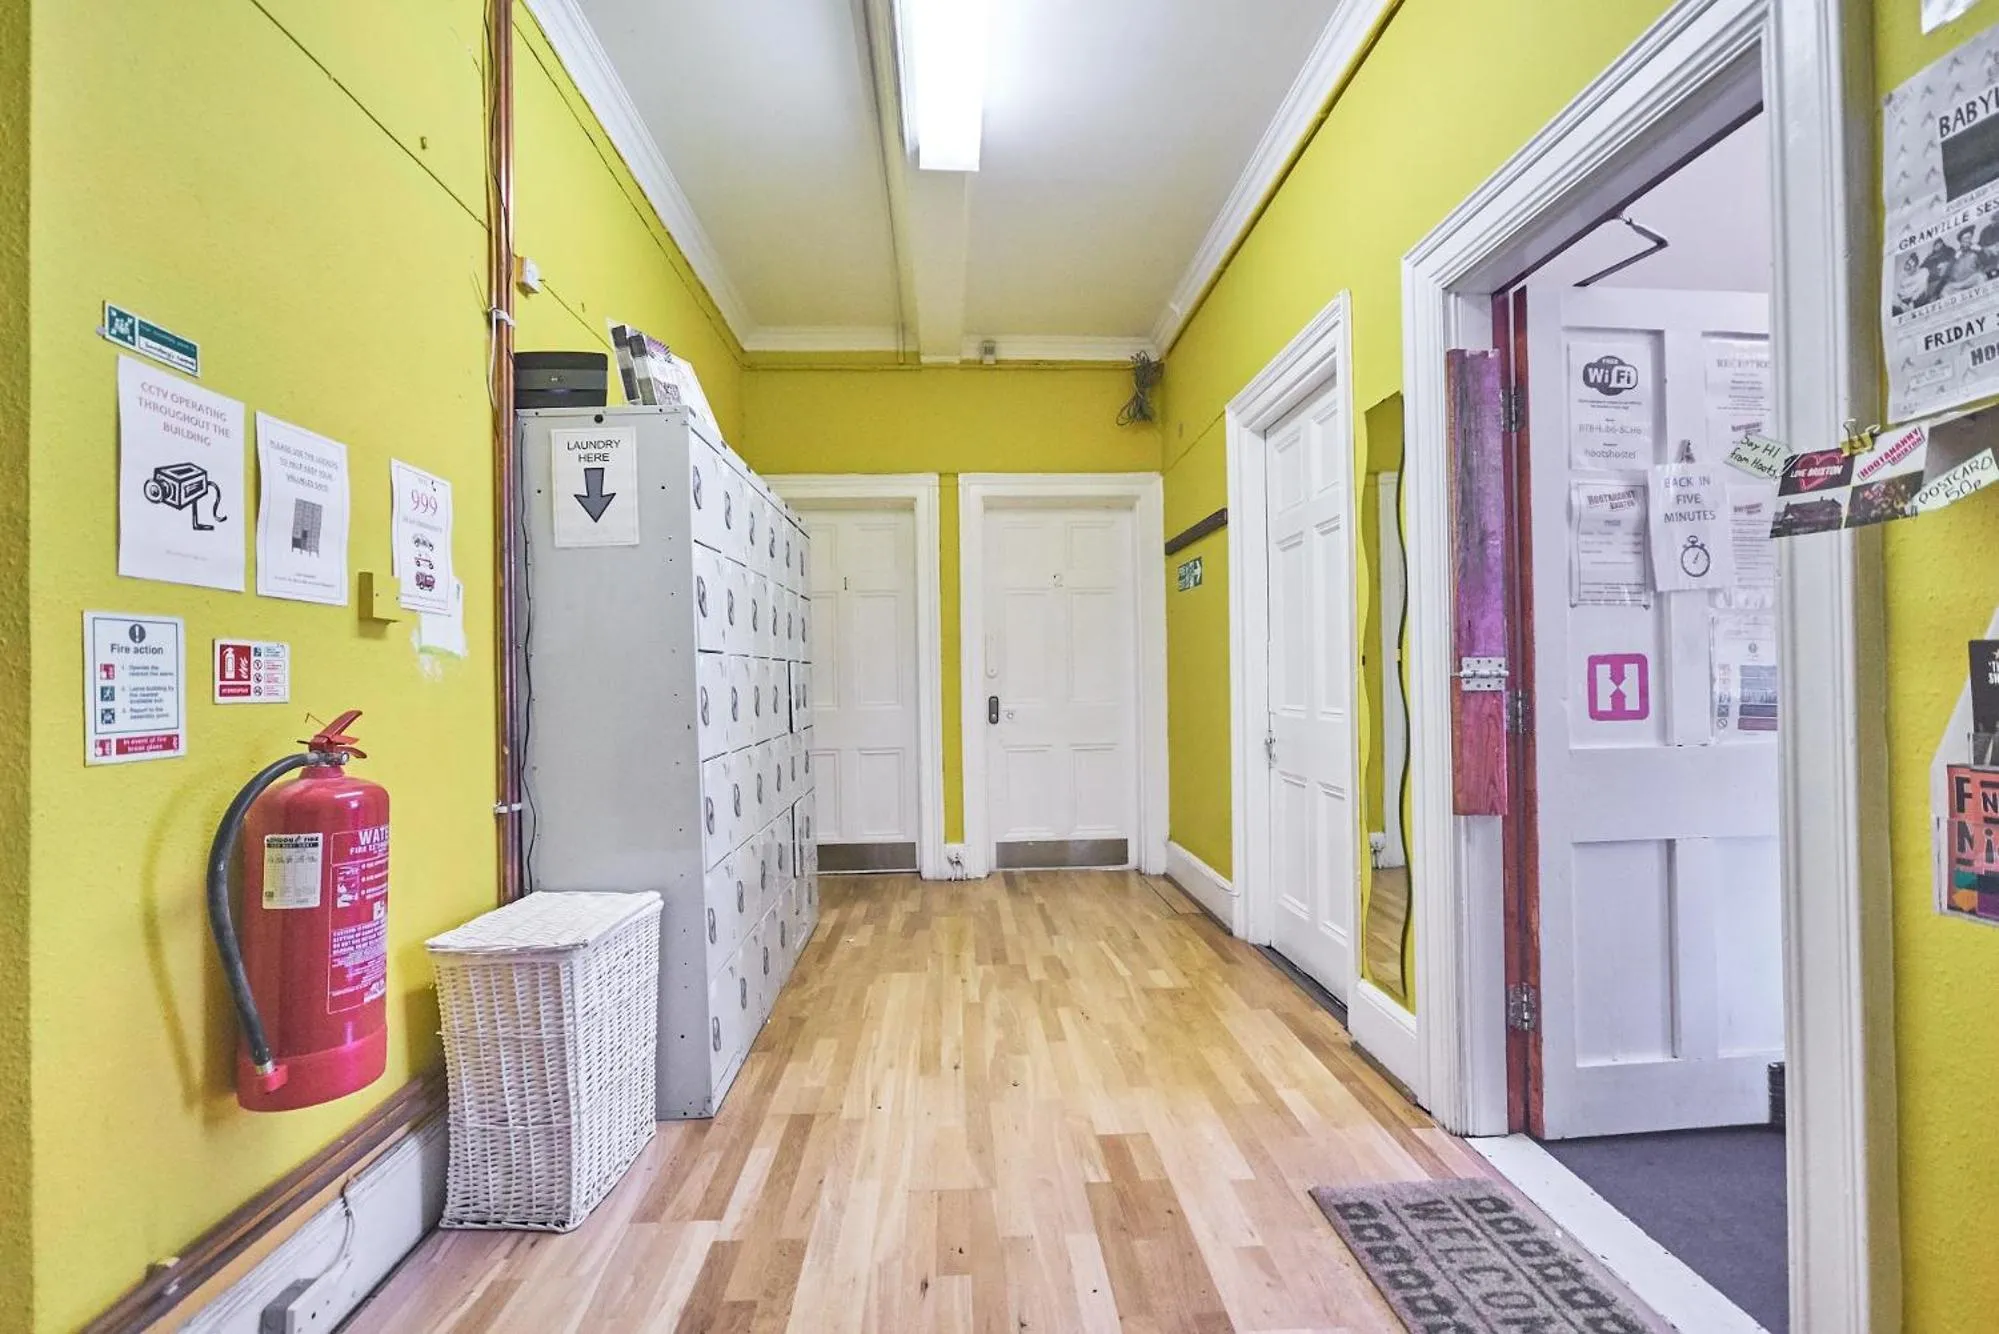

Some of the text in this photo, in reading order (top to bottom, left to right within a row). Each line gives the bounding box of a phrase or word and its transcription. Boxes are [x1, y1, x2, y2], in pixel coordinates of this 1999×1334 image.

[1899, 211, 1970, 251] GRANVILLE
[1924, 316, 1986, 351] FRIDAY
[1970, 341, 1999, 367] HO
[140, 381, 228, 422] CCTV OPERATING
[137, 397, 231, 439] THROUGHOUT THE
[163, 421, 212, 447] BUILDING
[567, 439, 621, 451] LAUNDRY
[1741, 433, 1760, 451] Say
[578, 452, 611, 463] HERE
[1730, 447, 1749, 463] from
[1664, 476, 1712, 488] BACK IN
[1919, 455, 1993, 504] POSTCARD
[411, 488, 438, 516] 999
[1676, 492, 1701, 504] FIVE
[1664, 510, 1717, 523] MINUTES
[110, 644, 164, 655] Fire action
